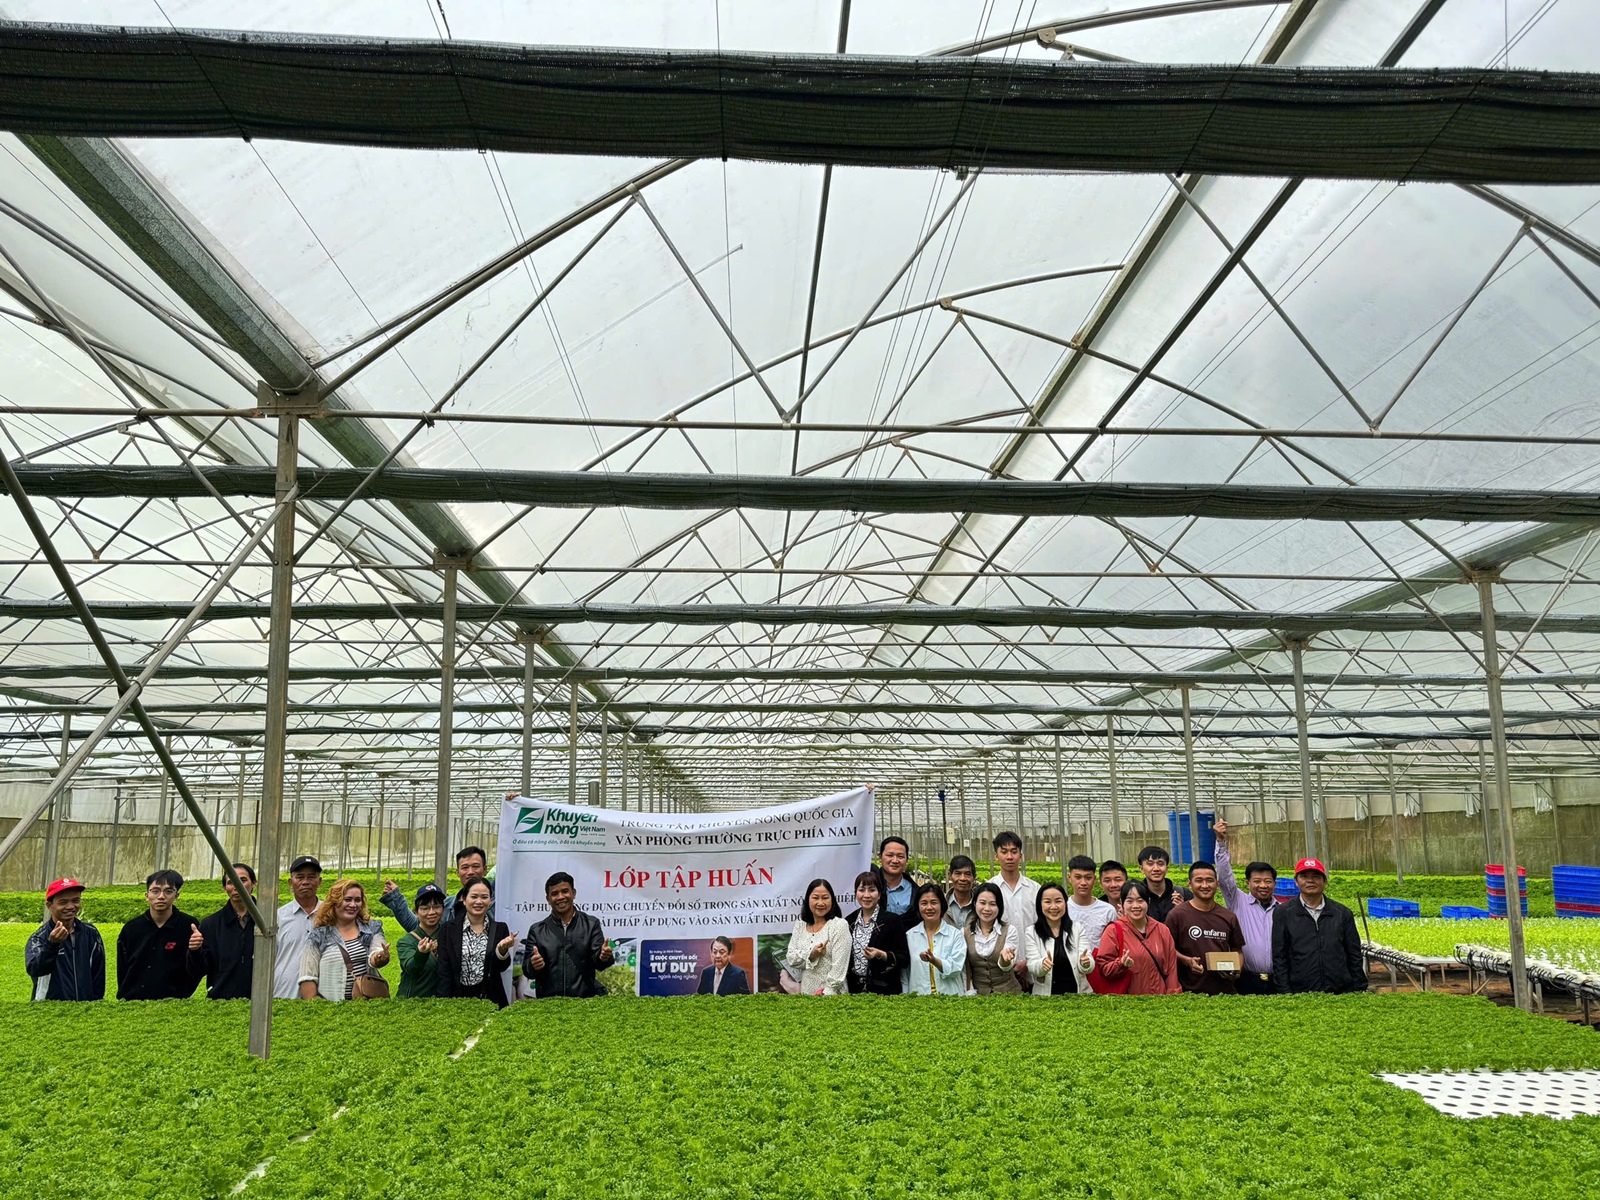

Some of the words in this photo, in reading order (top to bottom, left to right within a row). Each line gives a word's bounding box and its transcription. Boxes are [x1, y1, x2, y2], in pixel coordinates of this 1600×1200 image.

[619, 819, 663, 829] TRUNG
[793, 806, 830, 823] QUỐC
[831, 807, 854, 819] GIA
[544, 822, 579, 838] nông
[615, 833, 642, 846] VĂN
[645, 833, 692, 846] PHÒNG
[695, 831, 752, 845] THƯỜNG
[755, 829, 792, 844] TRỰC
[794, 825, 825, 840] PHÍA
[828, 826, 858, 838] NAM
[603, 865, 651, 889] LỚP
[655, 865, 702, 893] TẬP
[707, 859, 774, 888] HUẤN
[514, 901, 535, 914] TẬP
[537, 903, 552, 912] HU
[592, 903, 621, 914] DỤNG
[687, 898, 702, 910] SỐ
[703, 900, 738, 910] TRONG
[740, 897, 760, 909] SẢN
[761, 895, 789, 908] XUẤT
[790, 895, 805, 907] NÔ
[613, 915, 641, 927] PHÁP
[642, 915, 656, 927] ÁP
[657, 917, 686, 928] DỤNG
[688, 915, 710, 926] VÀO
[711, 913, 732, 925] SẢN
[733, 911, 761, 924] XUẤT
[762, 914, 788, 924] KINH
[1203, 929, 1227, 938] enfarm
[650, 961, 667, 973] TƯ
[670, 962, 698, 973] DUY
